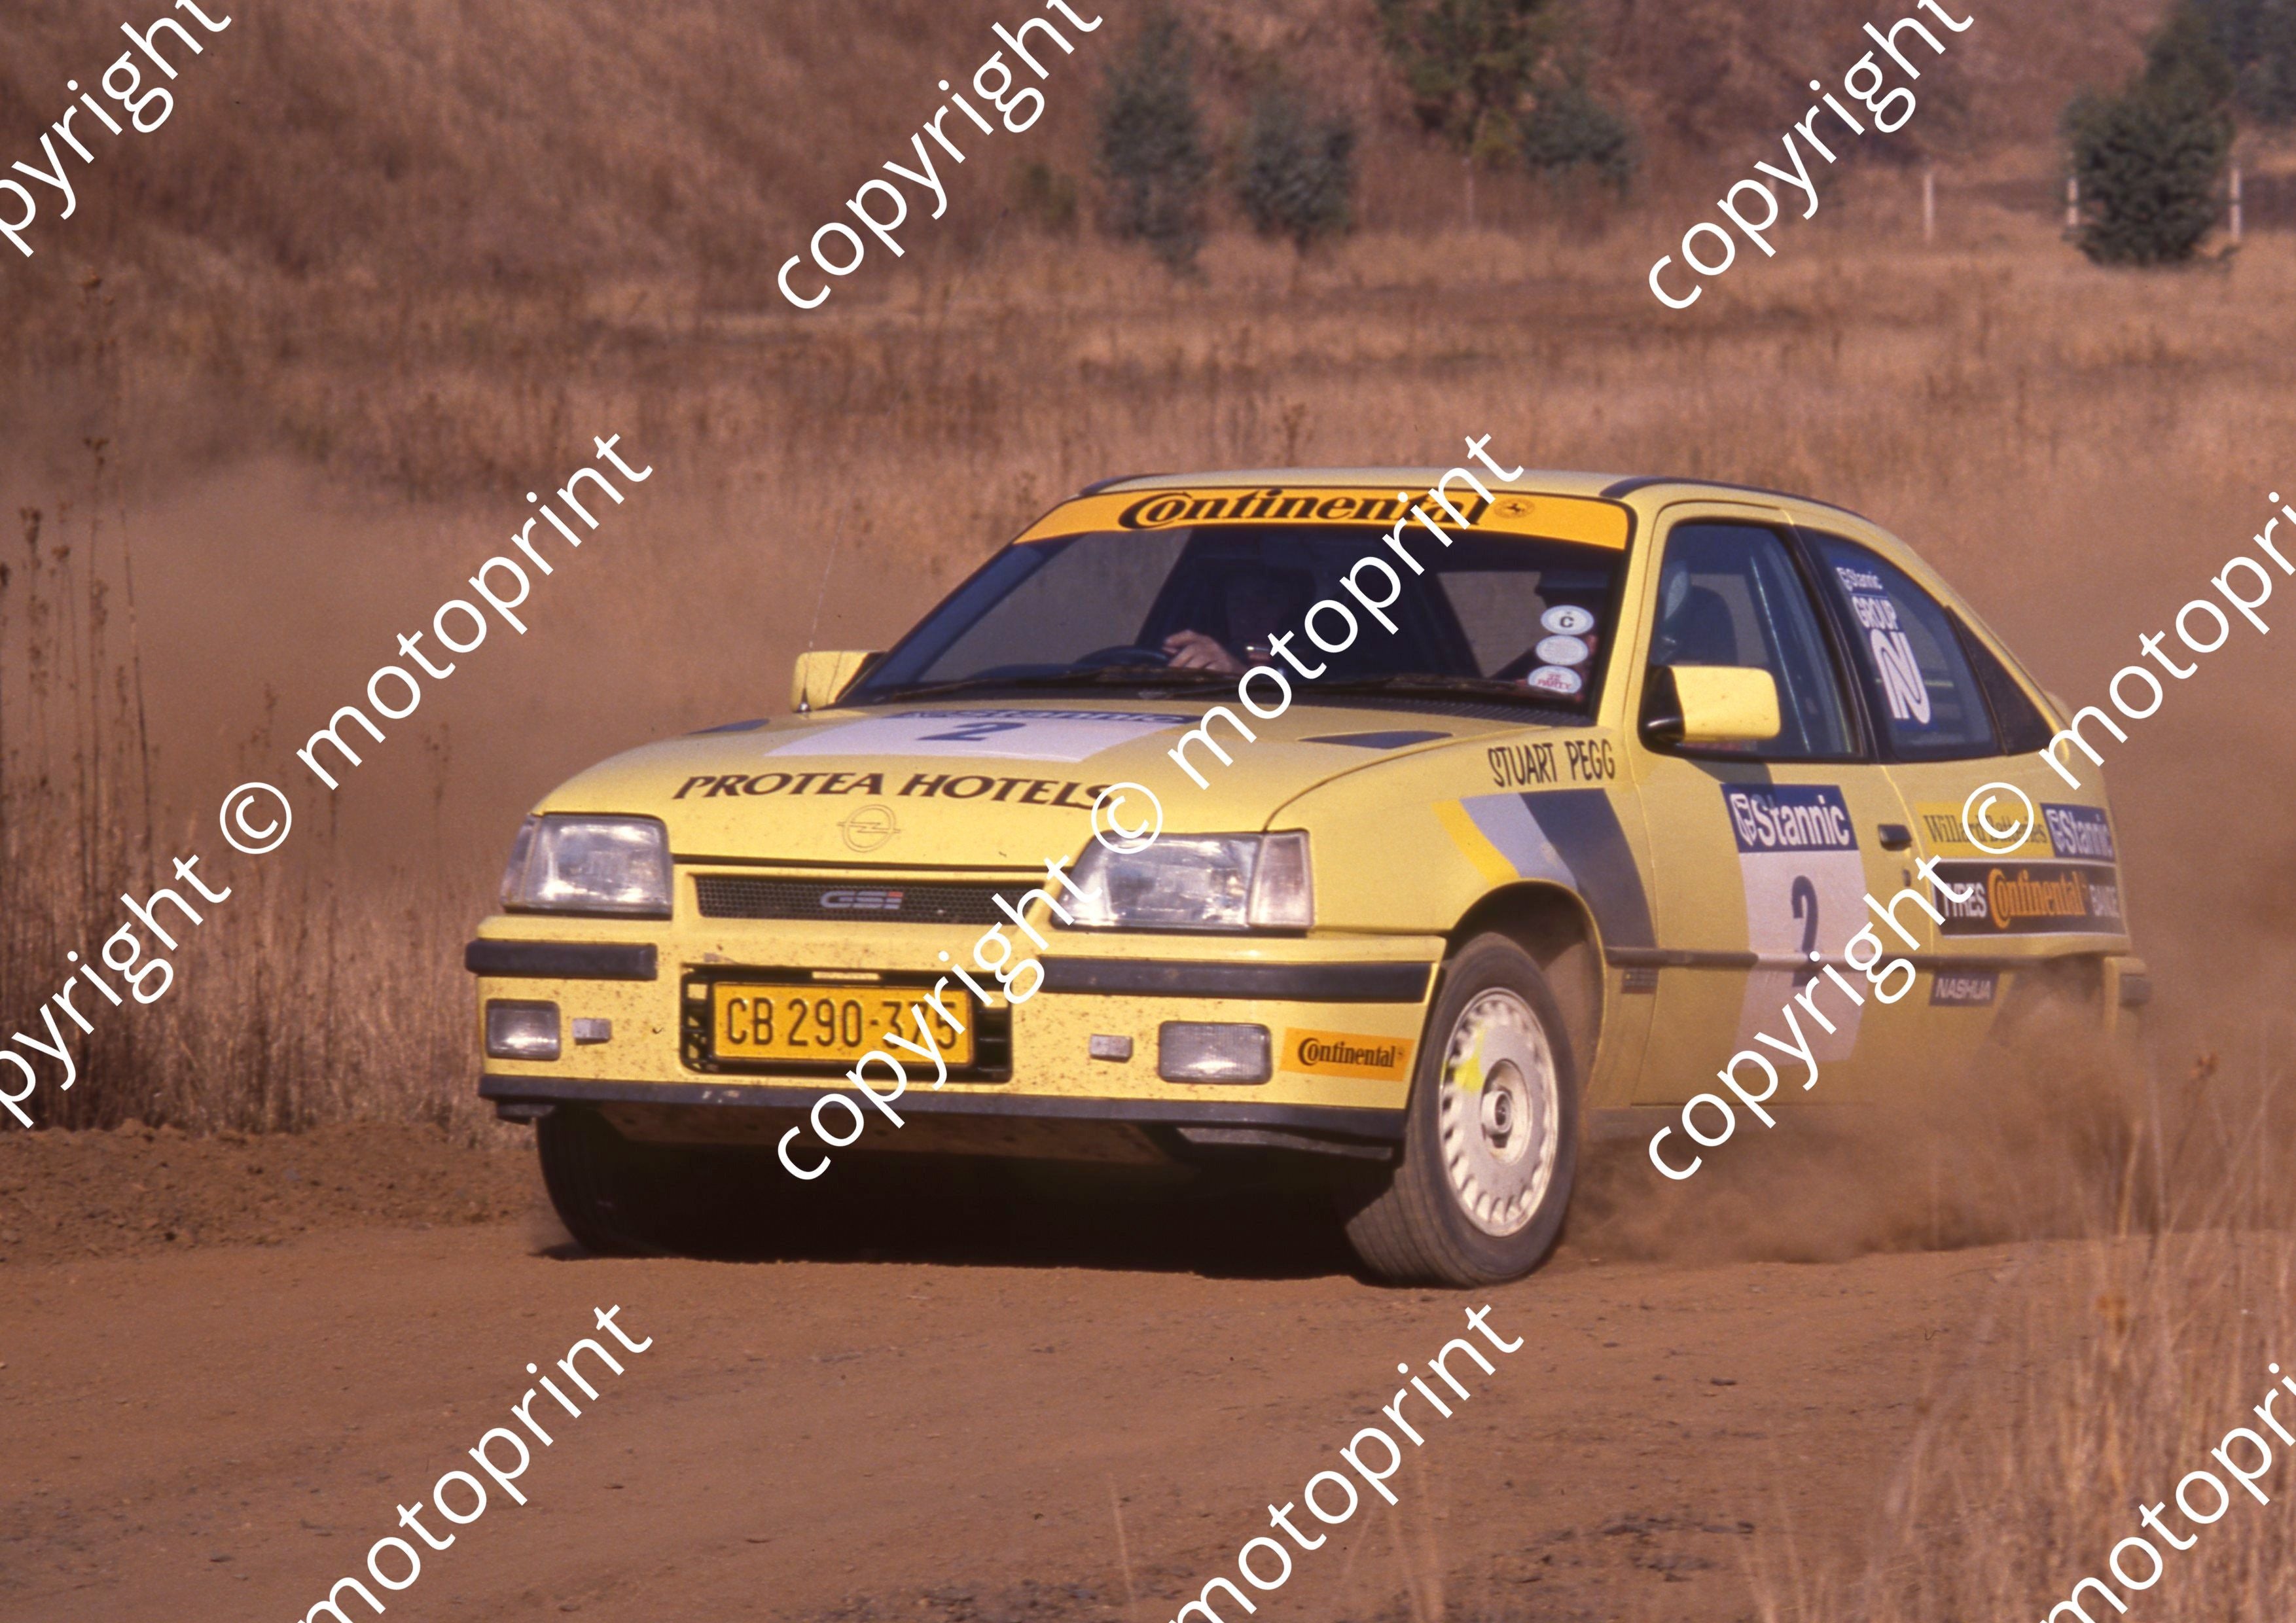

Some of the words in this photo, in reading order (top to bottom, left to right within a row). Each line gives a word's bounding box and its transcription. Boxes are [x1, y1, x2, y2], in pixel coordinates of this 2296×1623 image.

[1118, 488, 1484, 529] Continental
[1852, 596, 1899, 630] GROUP
[1870, 628, 1930, 724] N
[916, 721, 1026, 741] 2
[1488, 742, 1558, 787] STUART
[1564, 738, 1615, 781] PEGG
[672, 772, 891, 800] PROTEA
[897, 773, 1115, 810] HOTELS
[1751, 794, 1850, 846] Stannic
[1987, 868, 2087, 929] Continental
[1791, 875, 1820, 987] 2
[1935, 977, 1991, 1000] NASHUA
[726, 995, 774, 1046] CB
[787, 997, 957, 1050] 290-375
[1298, 1037, 1395, 1068] Continental
